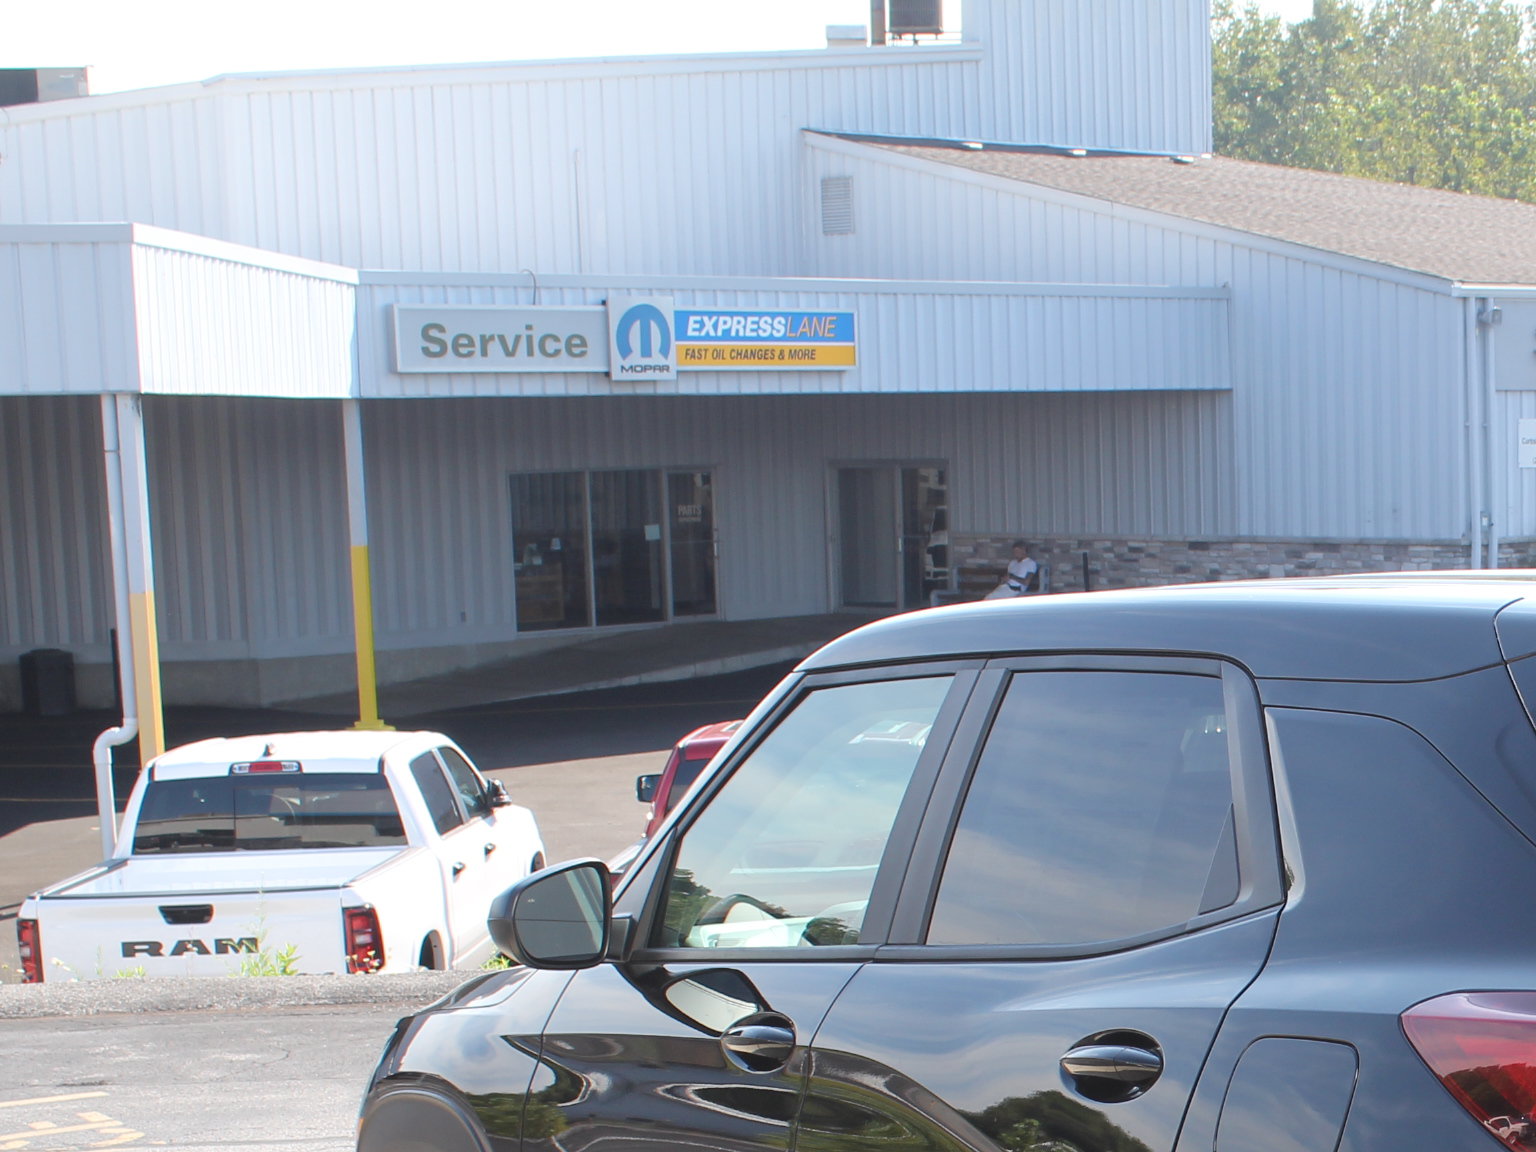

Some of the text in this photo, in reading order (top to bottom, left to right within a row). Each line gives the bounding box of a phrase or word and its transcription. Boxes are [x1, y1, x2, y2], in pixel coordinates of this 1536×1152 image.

[420, 322, 589, 359] Service
[684, 348, 817, 361] FAST OIL CHANGES & MORE
[620, 364, 671, 374] MOPAR
[121, 937, 259, 958] RAM
